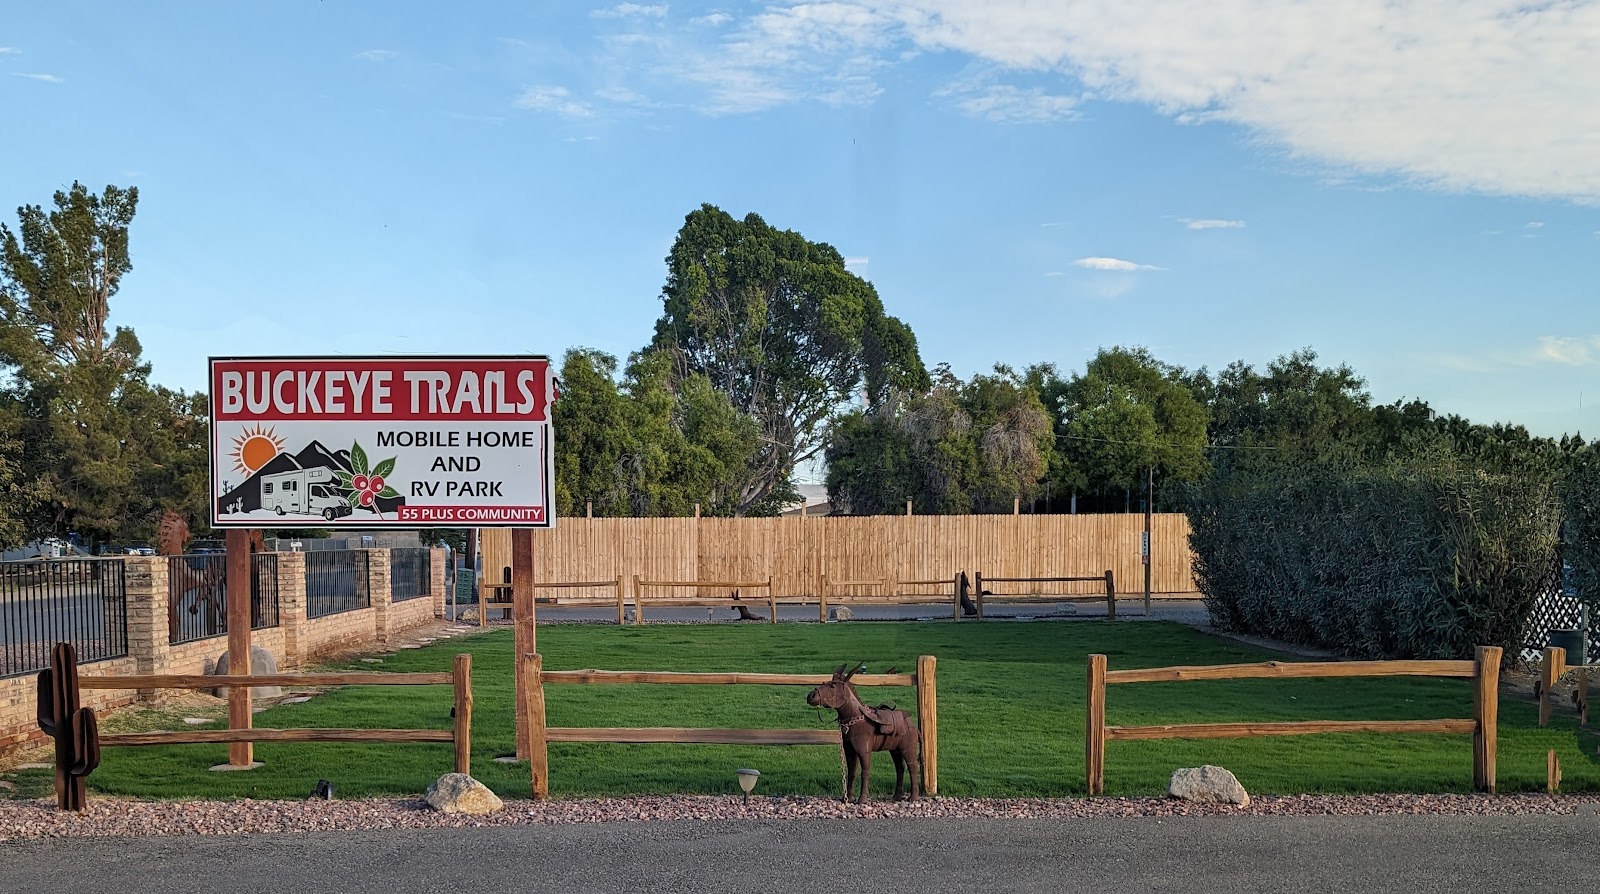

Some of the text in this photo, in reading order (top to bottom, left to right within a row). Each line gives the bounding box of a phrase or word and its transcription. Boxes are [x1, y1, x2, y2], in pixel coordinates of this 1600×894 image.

[222, 370, 393, 414] BUCKEYE
[376, 431, 534, 447] MOBILE HOME
[430, 456, 481, 472] AND
[410, 481, 503, 497] RV PARK
[402, 508, 541, 521] 55 PLUS COMMUNITY
